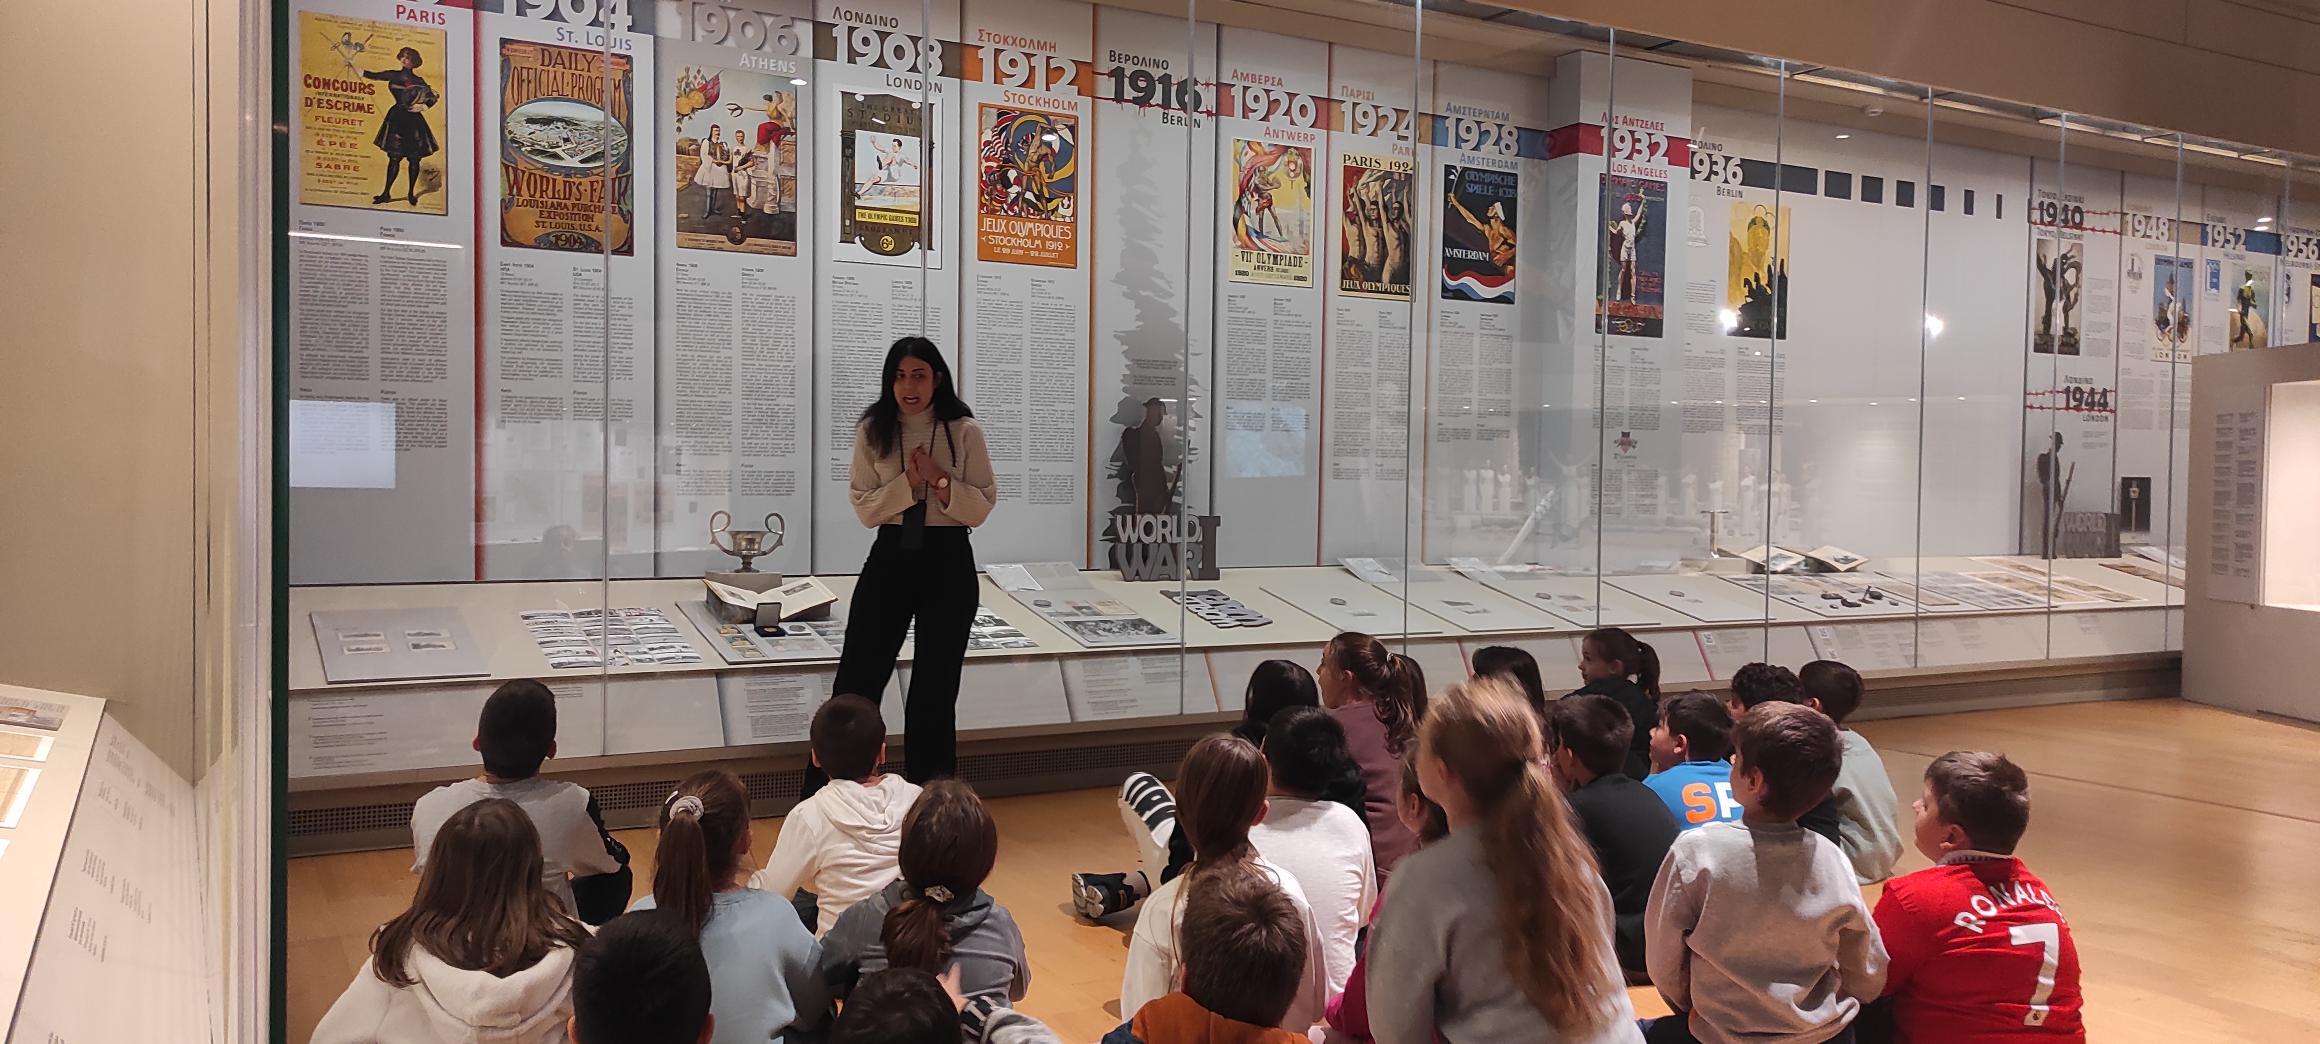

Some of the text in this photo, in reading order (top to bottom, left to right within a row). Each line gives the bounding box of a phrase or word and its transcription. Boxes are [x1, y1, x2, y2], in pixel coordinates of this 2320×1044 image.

[396, 4, 446, 25] PARIS
[832, 6, 899, 29] ΛΟΝΔΙΝΟ
[556, 26, 578, 43] ST.
[676, 0, 799, 56] 1906
[832, 24, 943, 77] 1908
[978, 28, 1057, 53] ΣΤΟΚΧΟΛΜΗ
[540, 48, 597, 73] DAILY
[739, 52, 797, 74] ATHENS
[978, 45, 1078, 94] 1912
[1109, 49, 1169, 70] ΒΕΡΟΛΙΝΟ
[303, 74, 376, 96] CONCOURS
[1231, 69, 1284, 87] ΑΜΒΕΡΣΑ
[1003, 89, 1078, 111] STOCKHOLM
[1109, 66, 1202, 114] 1916
[1341, 85, 1375, 101] ΠΑΡΙΣΙ
[304, 96, 376, 115] D'ESCRIME
[1231, 85, 1316, 127] 1920
[1445, 102, 1510, 122] ΑΜΣΤΕΡΝΤΑΜ
[314, 115, 365, 127] FLEURET
[847, 107, 923, 126] STADIU
[1162, 111, 1201, 129] BERLN
[1340, 98, 1420, 142] 1924
[1622, 115, 1665, 131] ΑΝΤΖΕΛΕΣ
[316, 139, 358, 150] ÉPÉE
[1264, 126, 1316, 143] ANTWERP
[1445, 117, 1519, 156] 1928
[1601, 126, 1668, 164] 1932
[1392, 143, 1415, 157] PARI
[1691, 139, 1723, 152] ΡΟΛΙΝΟ
[315, 162, 361, 172] SABRE
[1343, 153, 1382, 168] PARIS
[1460, 153, 1519, 170] AMSTERDAM
[1612, 161, 1668, 179] LOS ANGELES
[1691, 151, 1744, 186] 936
[1716, 185, 1744, 199] BERLIN
[515, 197, 618, 215] LOUISIANA PURCHE
[539, 209, 594, 222] EXPOSITION
[2039, 200, 2084, 229] 1940
[980, 217, 1072, 240] JEUX OLYMPIQUES
[2126, 213, 2169, 241] 1948
[2207, 223, 2246, 249] 1952
[988, 234, 1063, 251] STOCKHOLM 1912
[2281, 233, 2318, 259] 1956
[1240, 251, 1304, 268] VII OLYMPIADE
[1342, 280, 1411, 294] JEUX OLYMPIQUES
[2064, 386, 2109, 409] 1944
[1116, 514, 1202, 544] WORLD
[1117, 543, 1203, 582] WAR
[1954, 880, 2067, 934] RONALD
[2009, 923, 2060, 1026] 7
